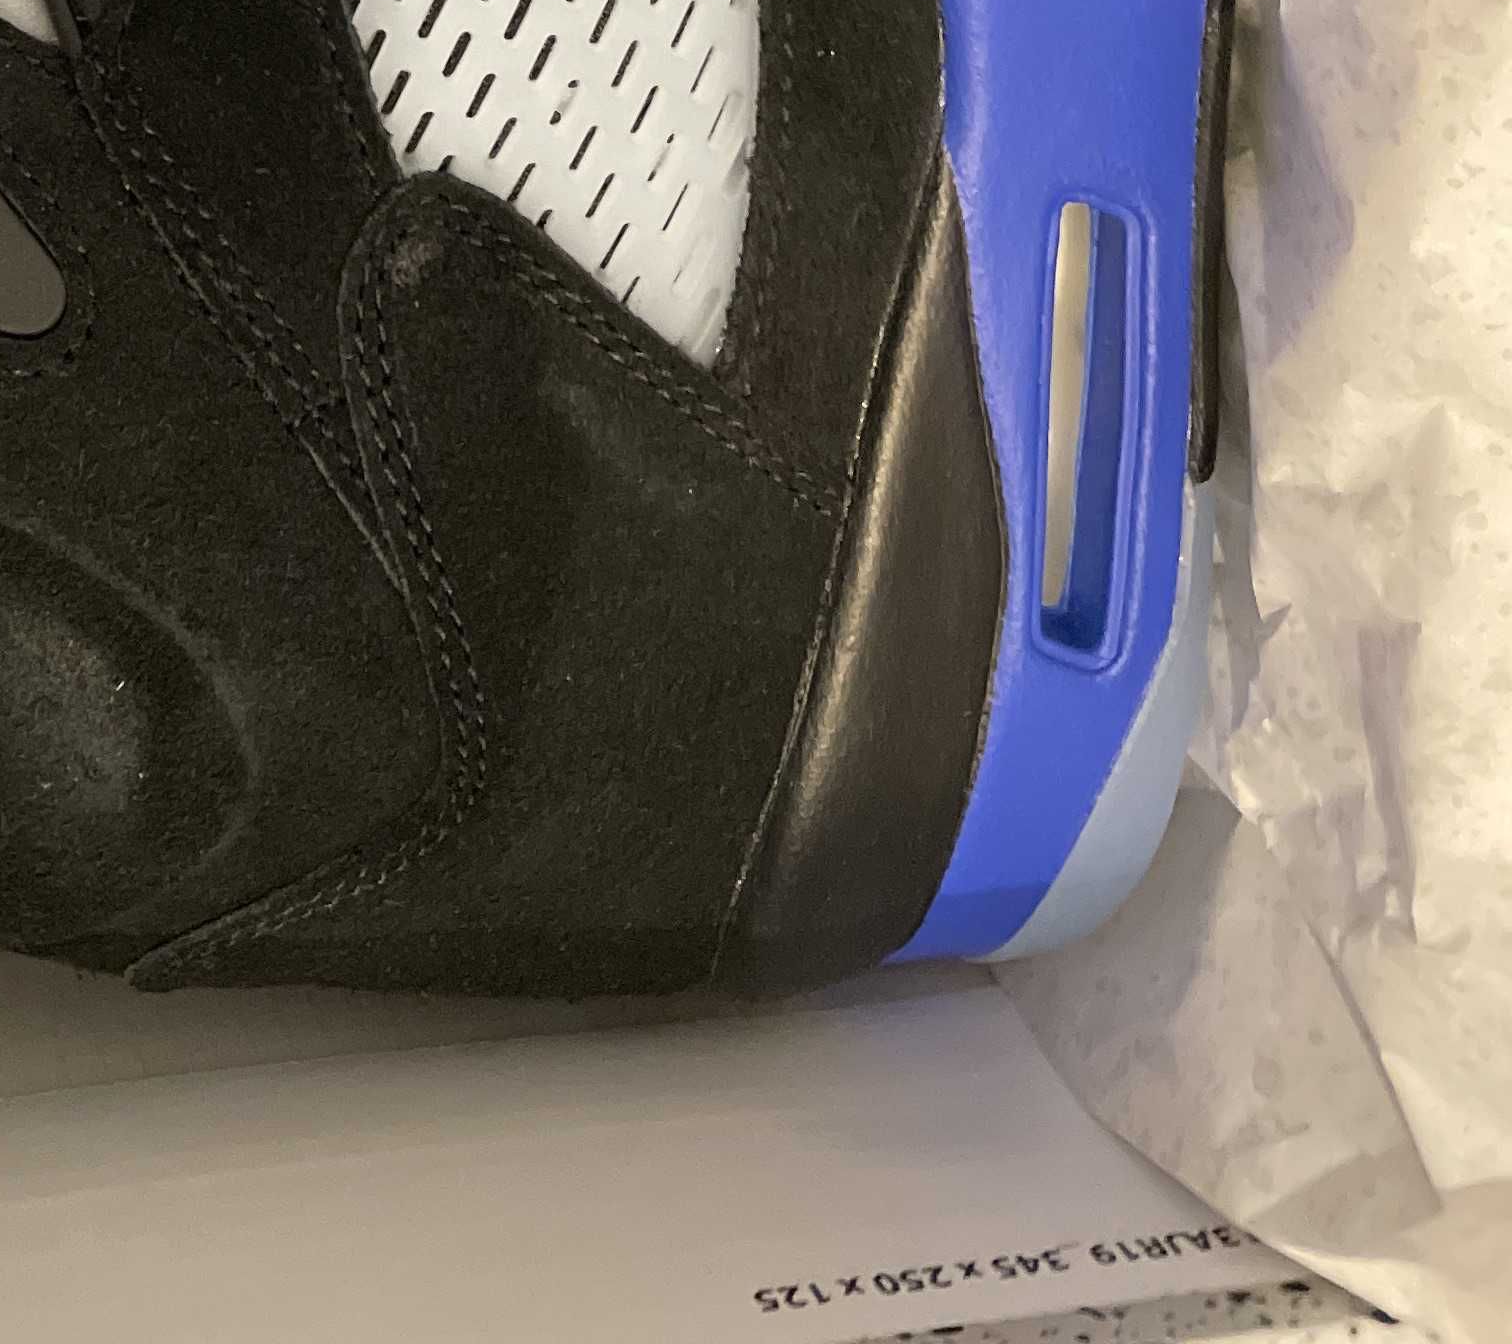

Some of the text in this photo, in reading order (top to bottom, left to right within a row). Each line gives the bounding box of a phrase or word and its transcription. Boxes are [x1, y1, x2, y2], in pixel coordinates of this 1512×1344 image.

[873, 1264, 953, 1297] 250
[954, 1260, 984, 1281] x
[753, 1282, 831, 1313] 125
[835, 1275, 866, 1297] x
